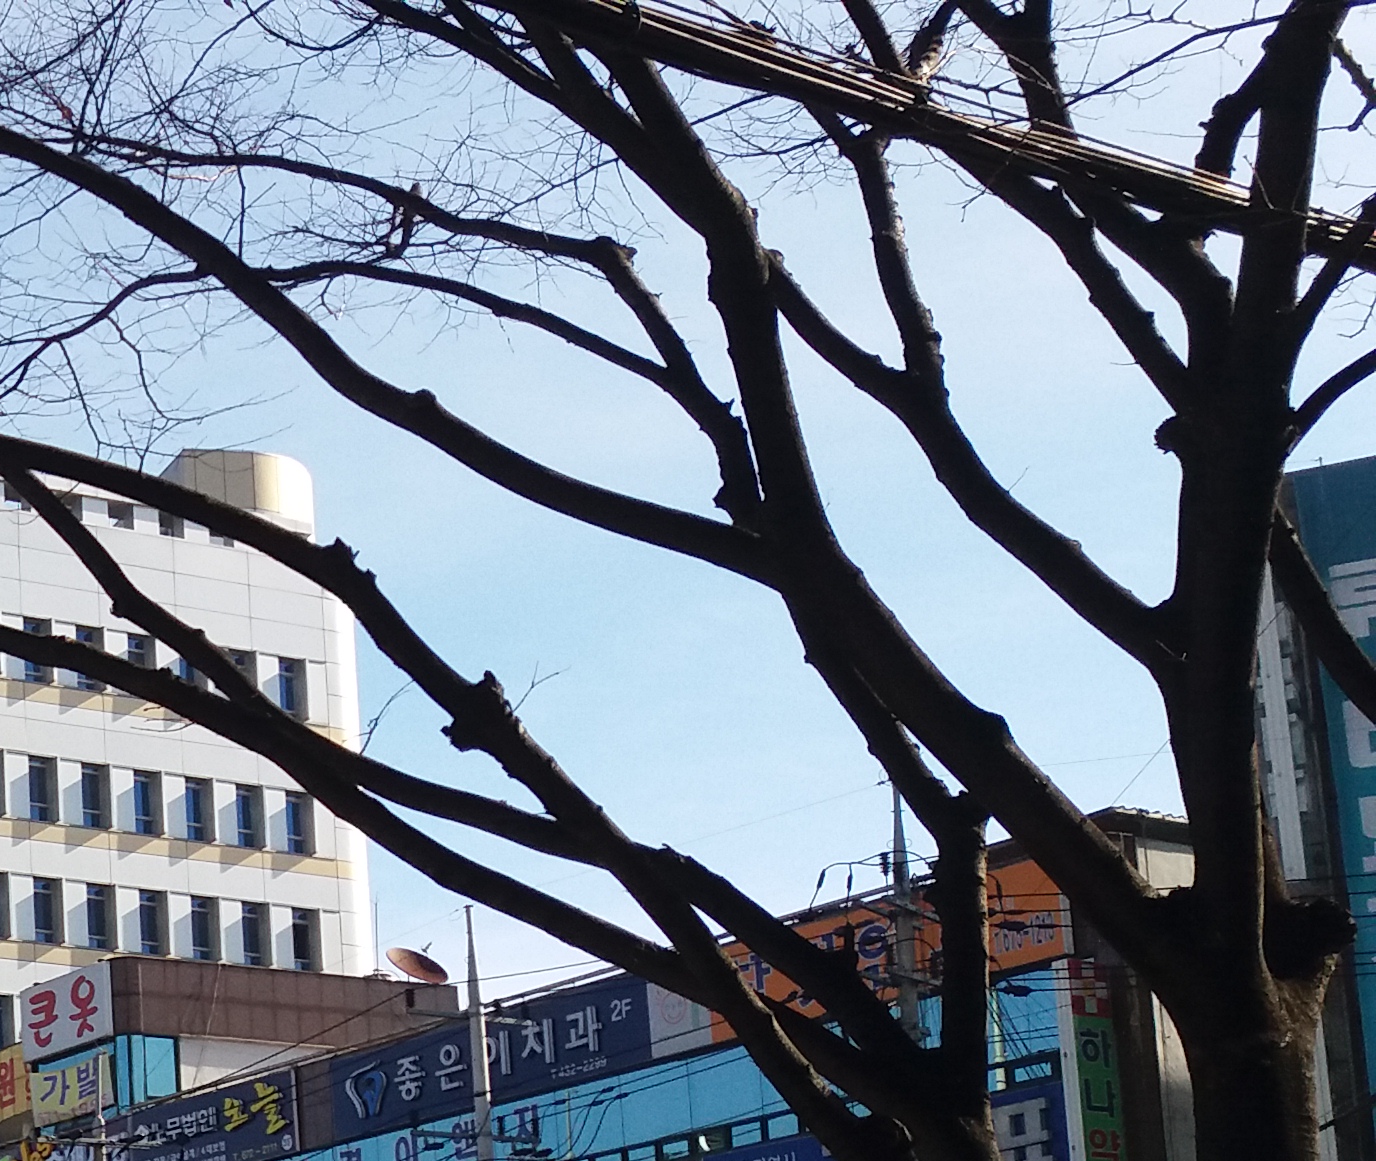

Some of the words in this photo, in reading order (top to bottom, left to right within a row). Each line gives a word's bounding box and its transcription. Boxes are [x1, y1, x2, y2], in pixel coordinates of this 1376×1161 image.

[392, 1004, 603, 1102] 좋은이치과
[610, 998, 633, 1022] 2F
[40, 1056, 97, 1106] 가발
[222, 1082, 289, 1134] 오늘
